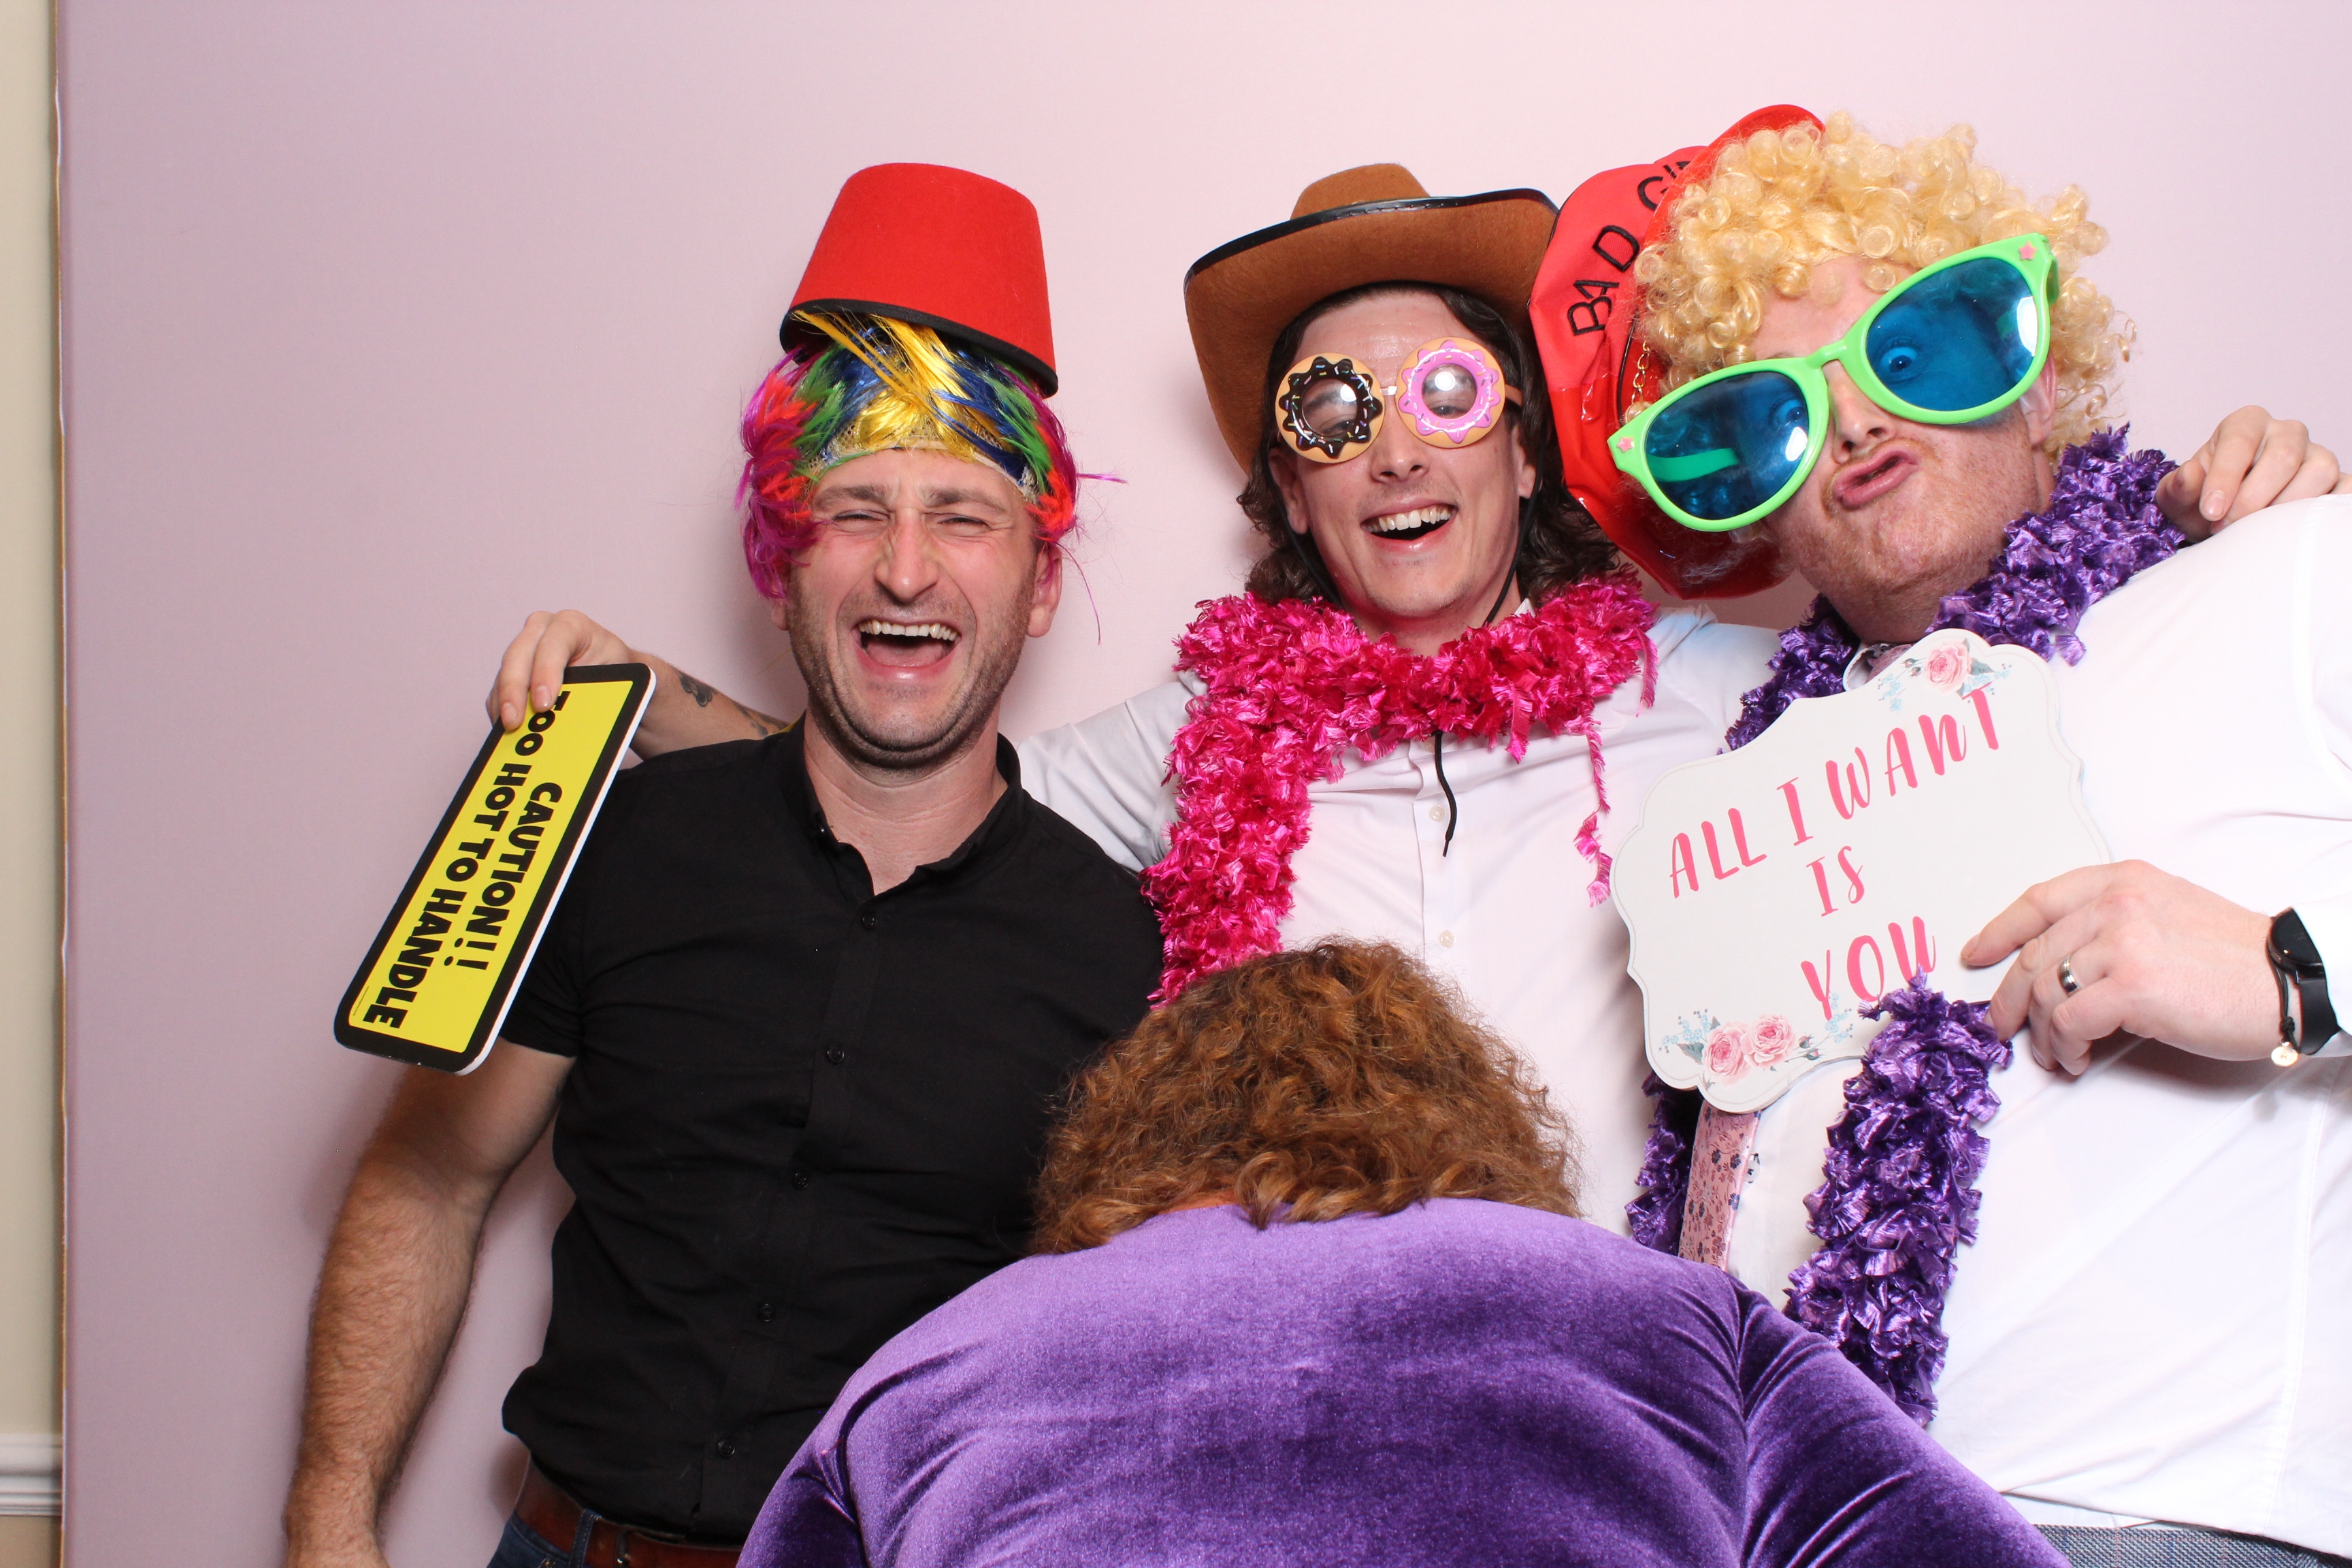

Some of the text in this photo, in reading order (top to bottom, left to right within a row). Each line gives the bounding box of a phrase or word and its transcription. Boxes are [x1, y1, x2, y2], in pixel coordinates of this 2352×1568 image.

[1567, 225, 1640, 336] BAD
[473, 763, 532, 832] HOT
[1669, 683, 1999, 899] ALL I WANT
[444, 782, 563, 971] CAUTION!!
[446, 838, 493, 883] TO
[1806, 845, 1865, 917] IS
[362, 887, 468, 1029] HANDLE
[1800, 916, 1937, 1021] YOU
